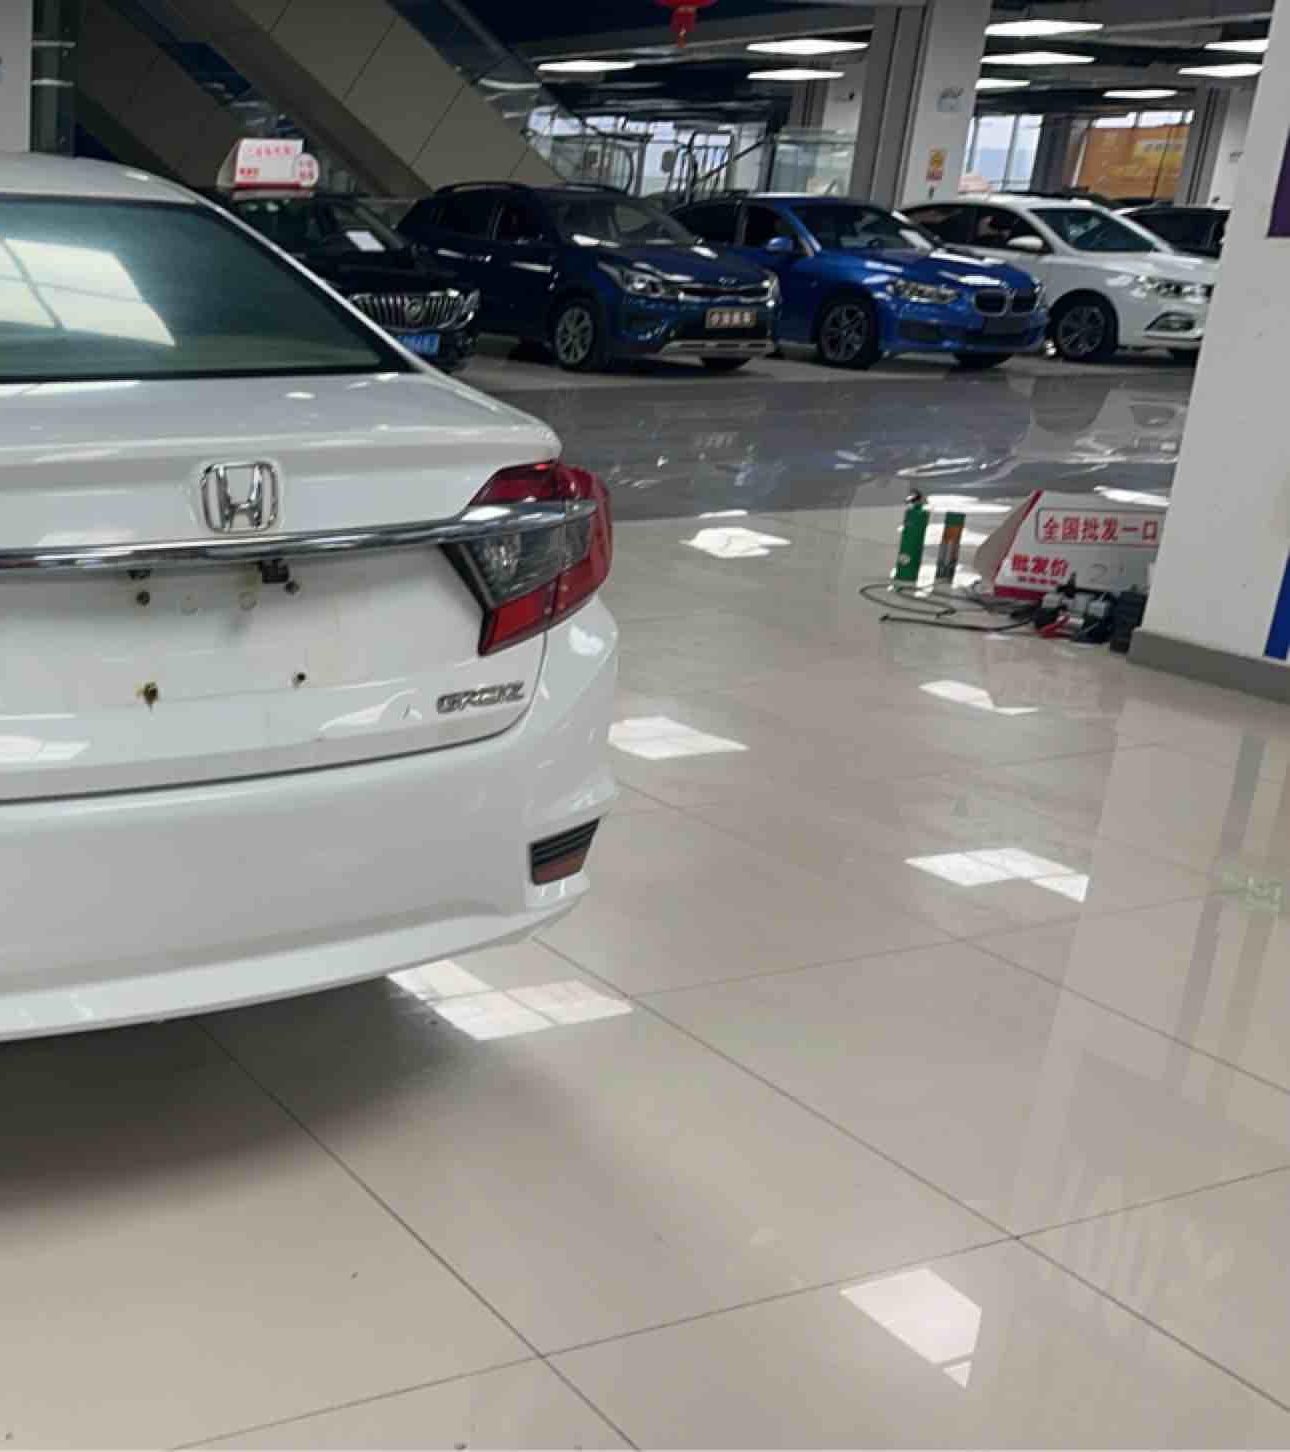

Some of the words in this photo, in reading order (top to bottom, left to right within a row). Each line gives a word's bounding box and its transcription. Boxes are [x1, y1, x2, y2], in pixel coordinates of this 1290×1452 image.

[1043, 514, 1159, 542] 全国批发一口
[1011, 553, 1070, 578] 批发价
